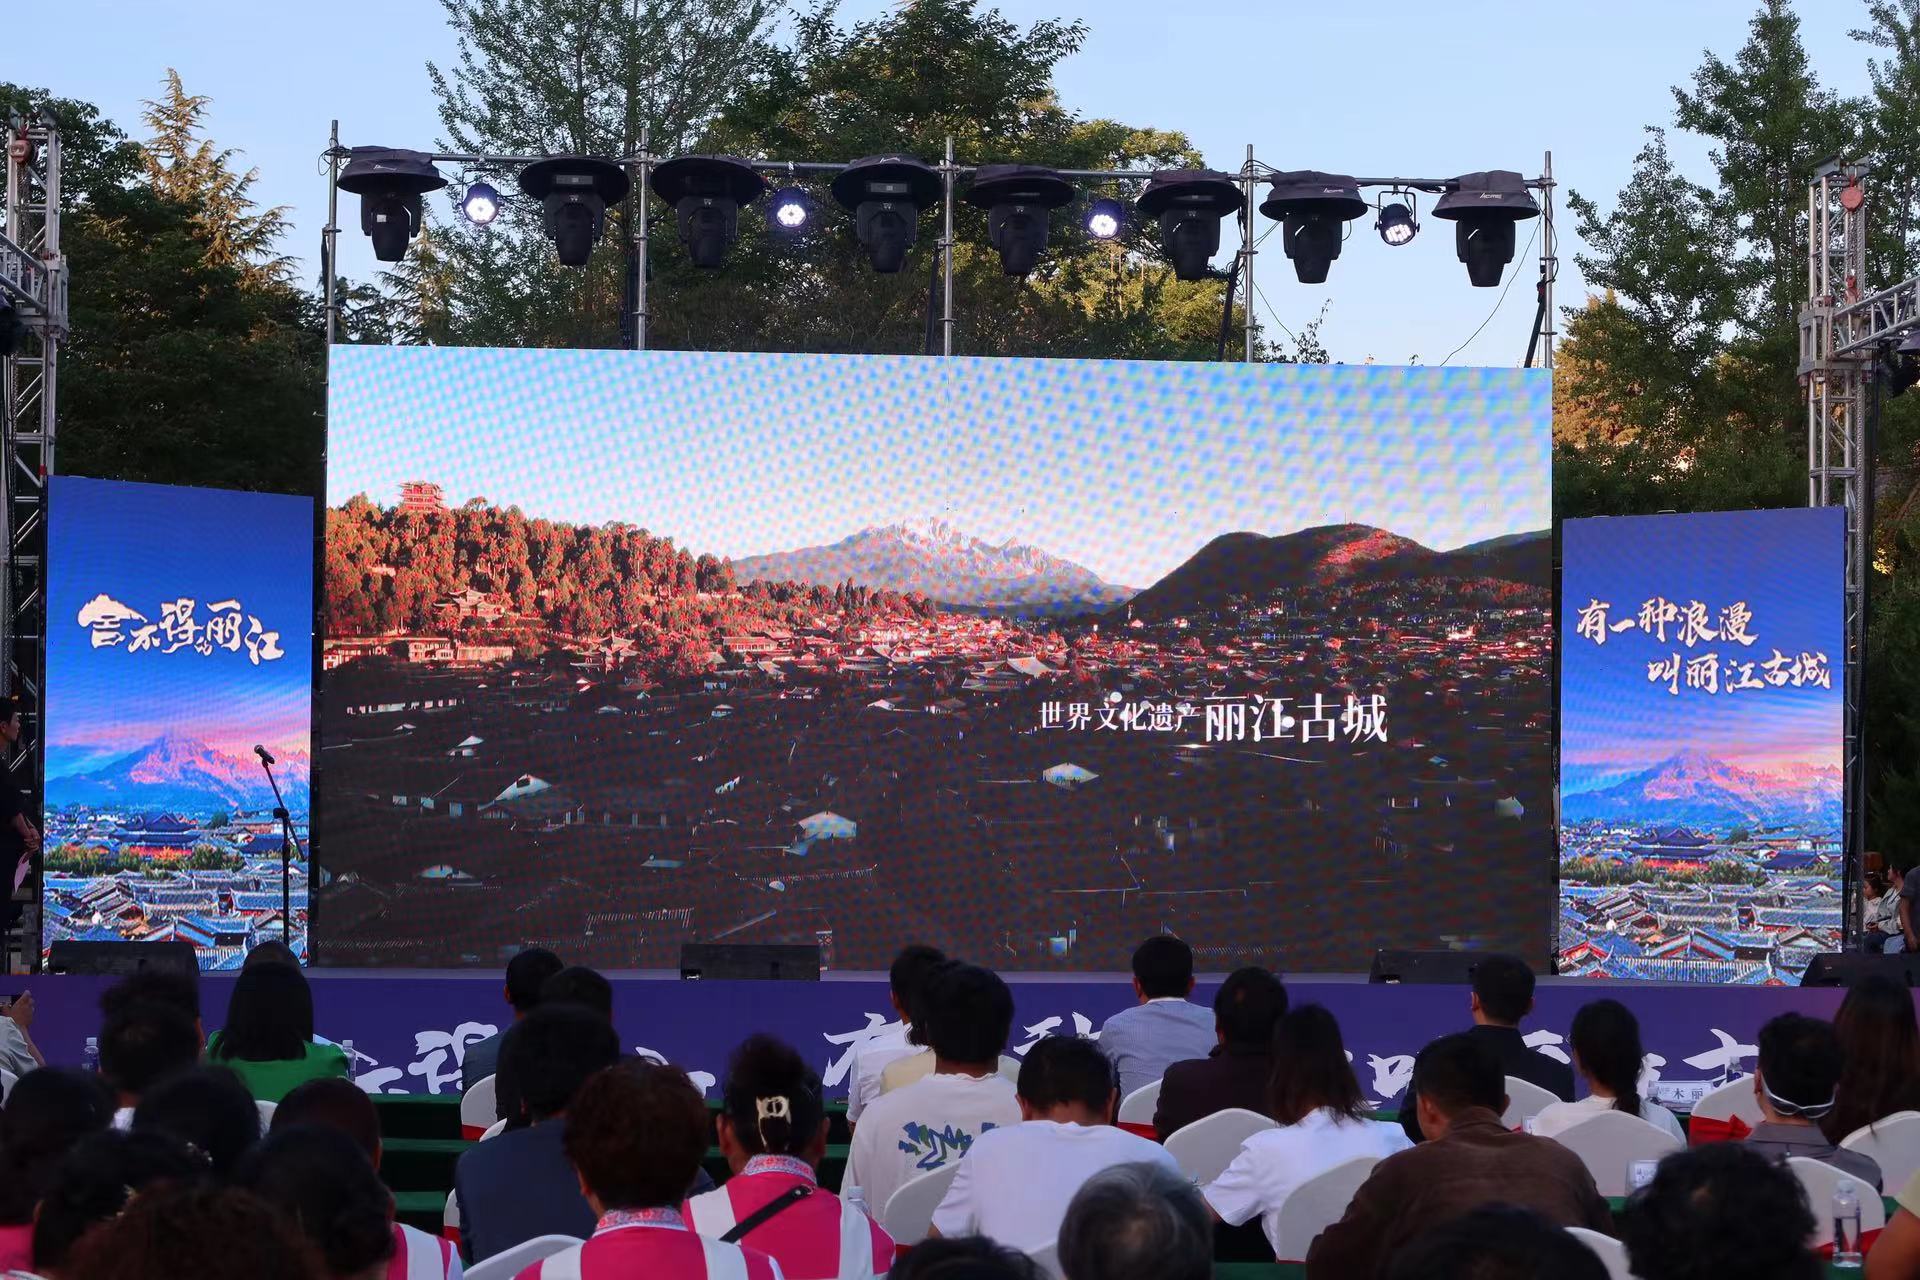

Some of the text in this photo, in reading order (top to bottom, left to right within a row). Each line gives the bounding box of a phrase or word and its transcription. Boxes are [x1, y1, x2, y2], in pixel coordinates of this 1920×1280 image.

[1576, 596, 1760, 648] 有一种浪漫
[1647, 649, 1832, 695] 叫丽江古城
[1038, 692, 1389, 743] 世界文化遗产 丽江古城
